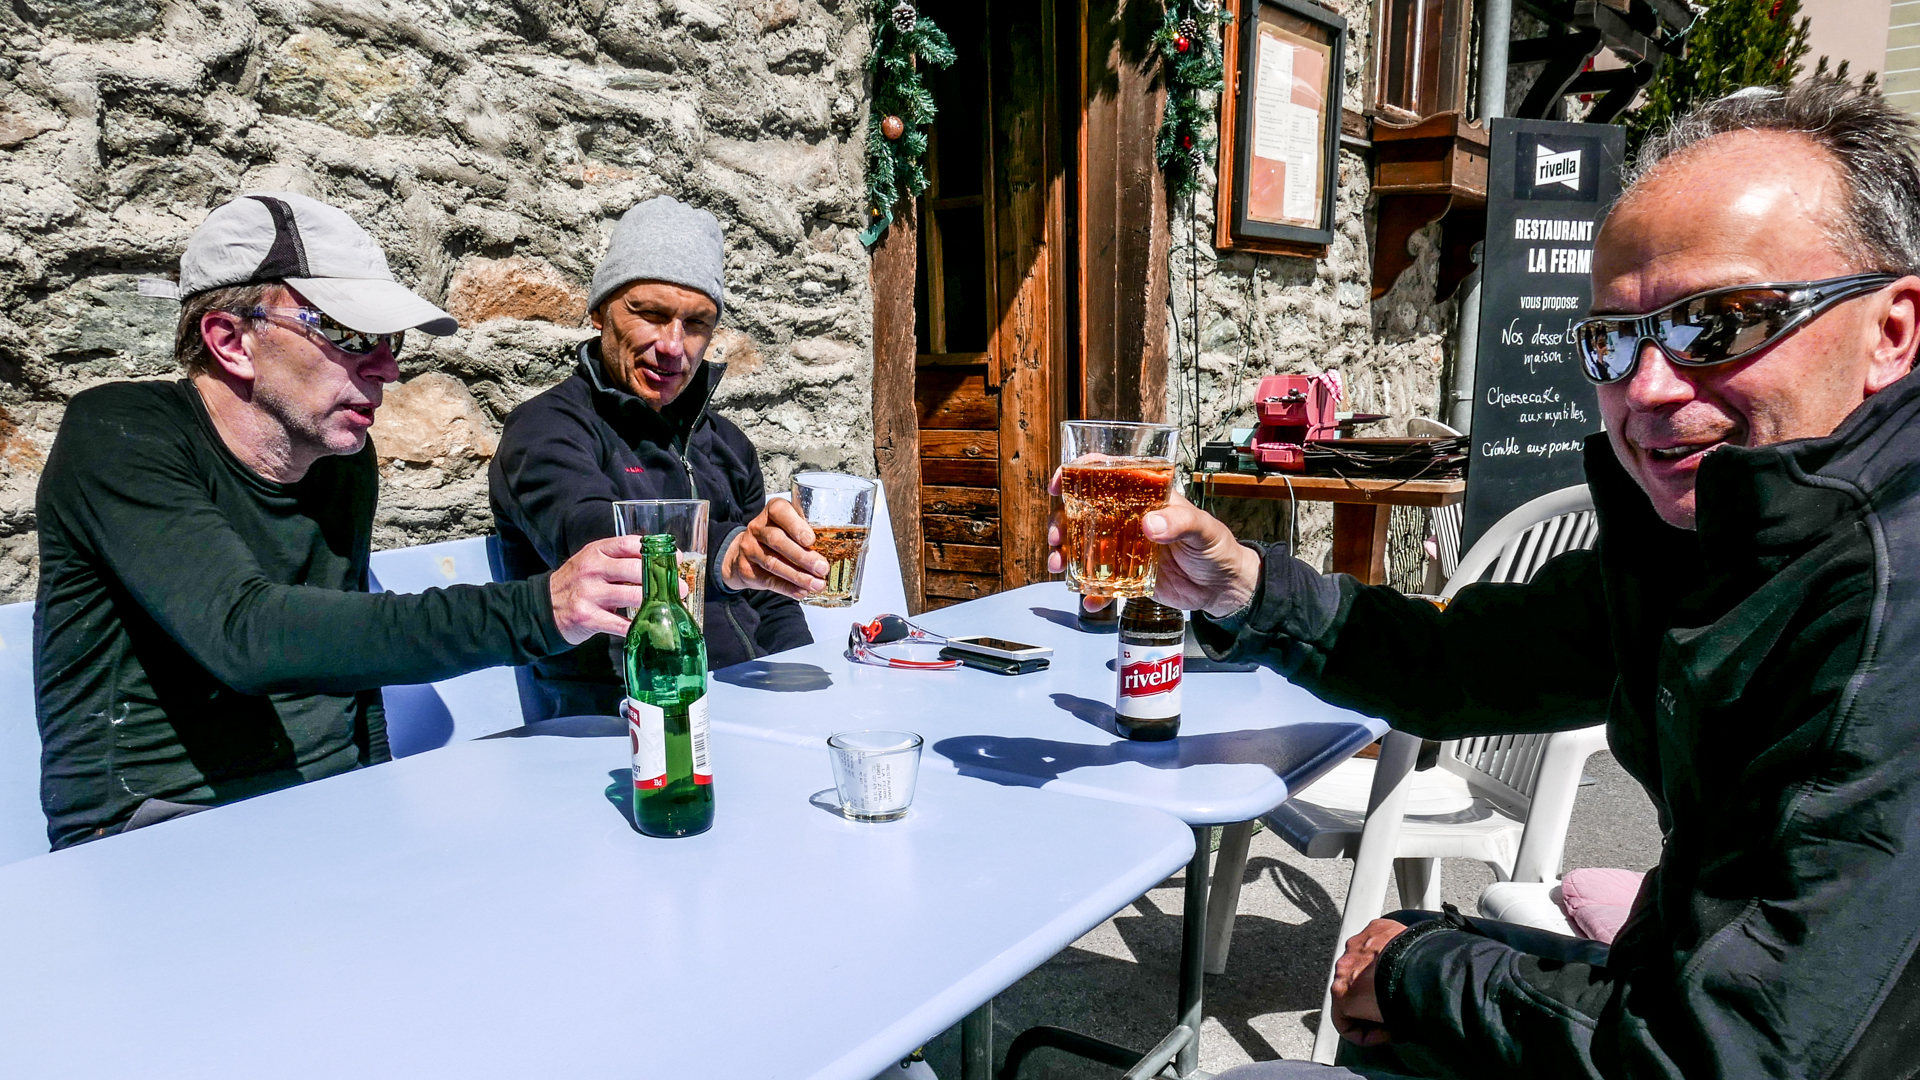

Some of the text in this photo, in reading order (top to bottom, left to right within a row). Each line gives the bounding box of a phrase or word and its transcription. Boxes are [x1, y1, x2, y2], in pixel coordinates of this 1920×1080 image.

[1539, 157, 1576, 179] rivella
[1515, 218, 1595, 241] RESTAURANT
[1528, 248, 1593, 274] LA FERM
[1520, 296, 1579, 311] vous propose:
[1501, 317, 1577, 346] Nos desserts
[1519, 412, 1543, 423] aux
[1124, 661, 1180, 689] rivella
